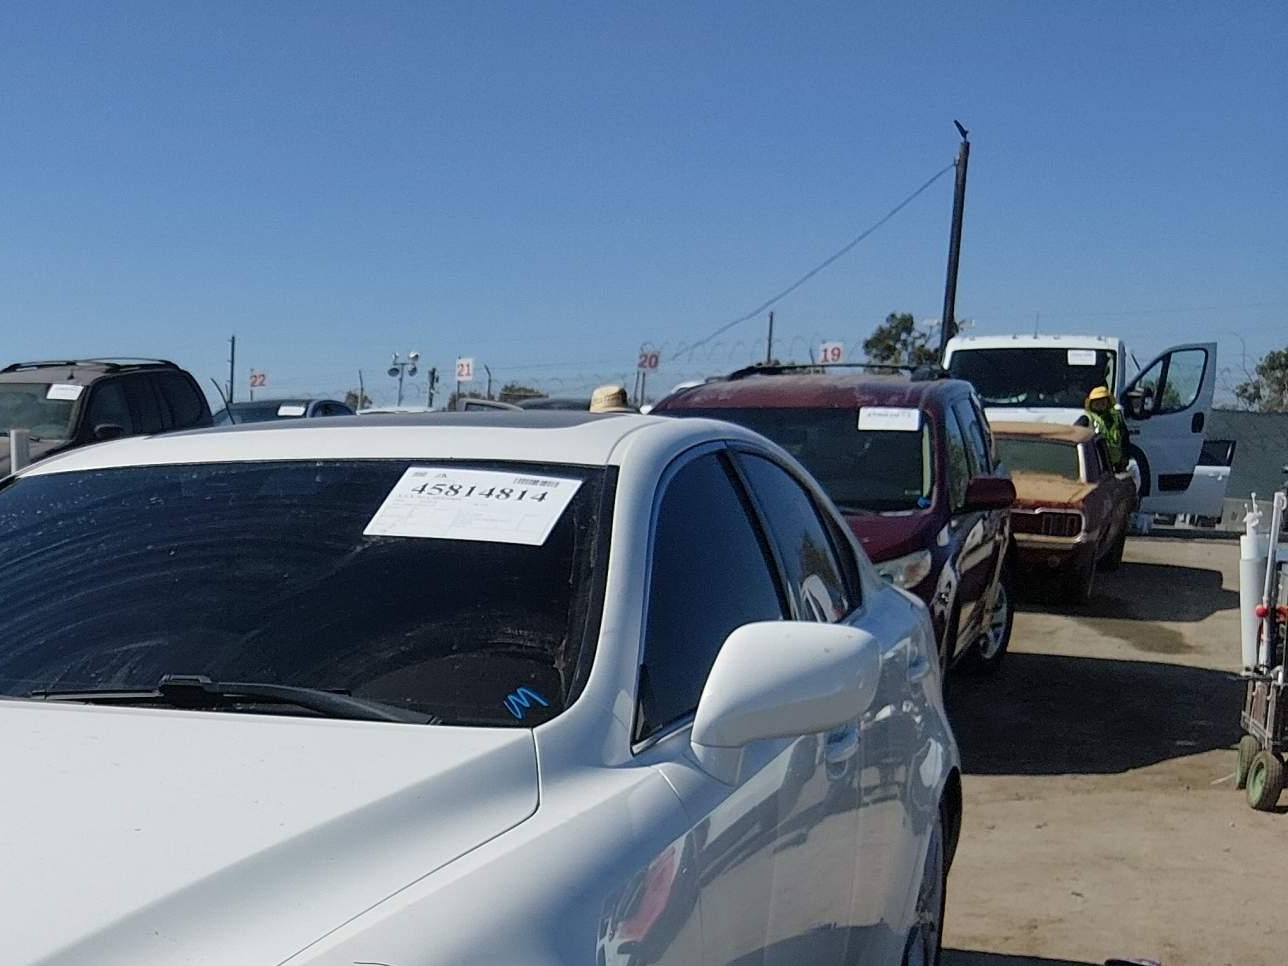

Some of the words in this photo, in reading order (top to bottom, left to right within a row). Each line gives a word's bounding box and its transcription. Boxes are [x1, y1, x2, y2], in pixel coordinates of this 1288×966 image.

[638, 353, 659, 369] 20
[822, 346, 841, 363] 19
[457, 362, 471, 377] 21
[249, 374, 266, 388] 22
[412, 482, 549, 503] 45814814
[503, 687, 549, 720] M
